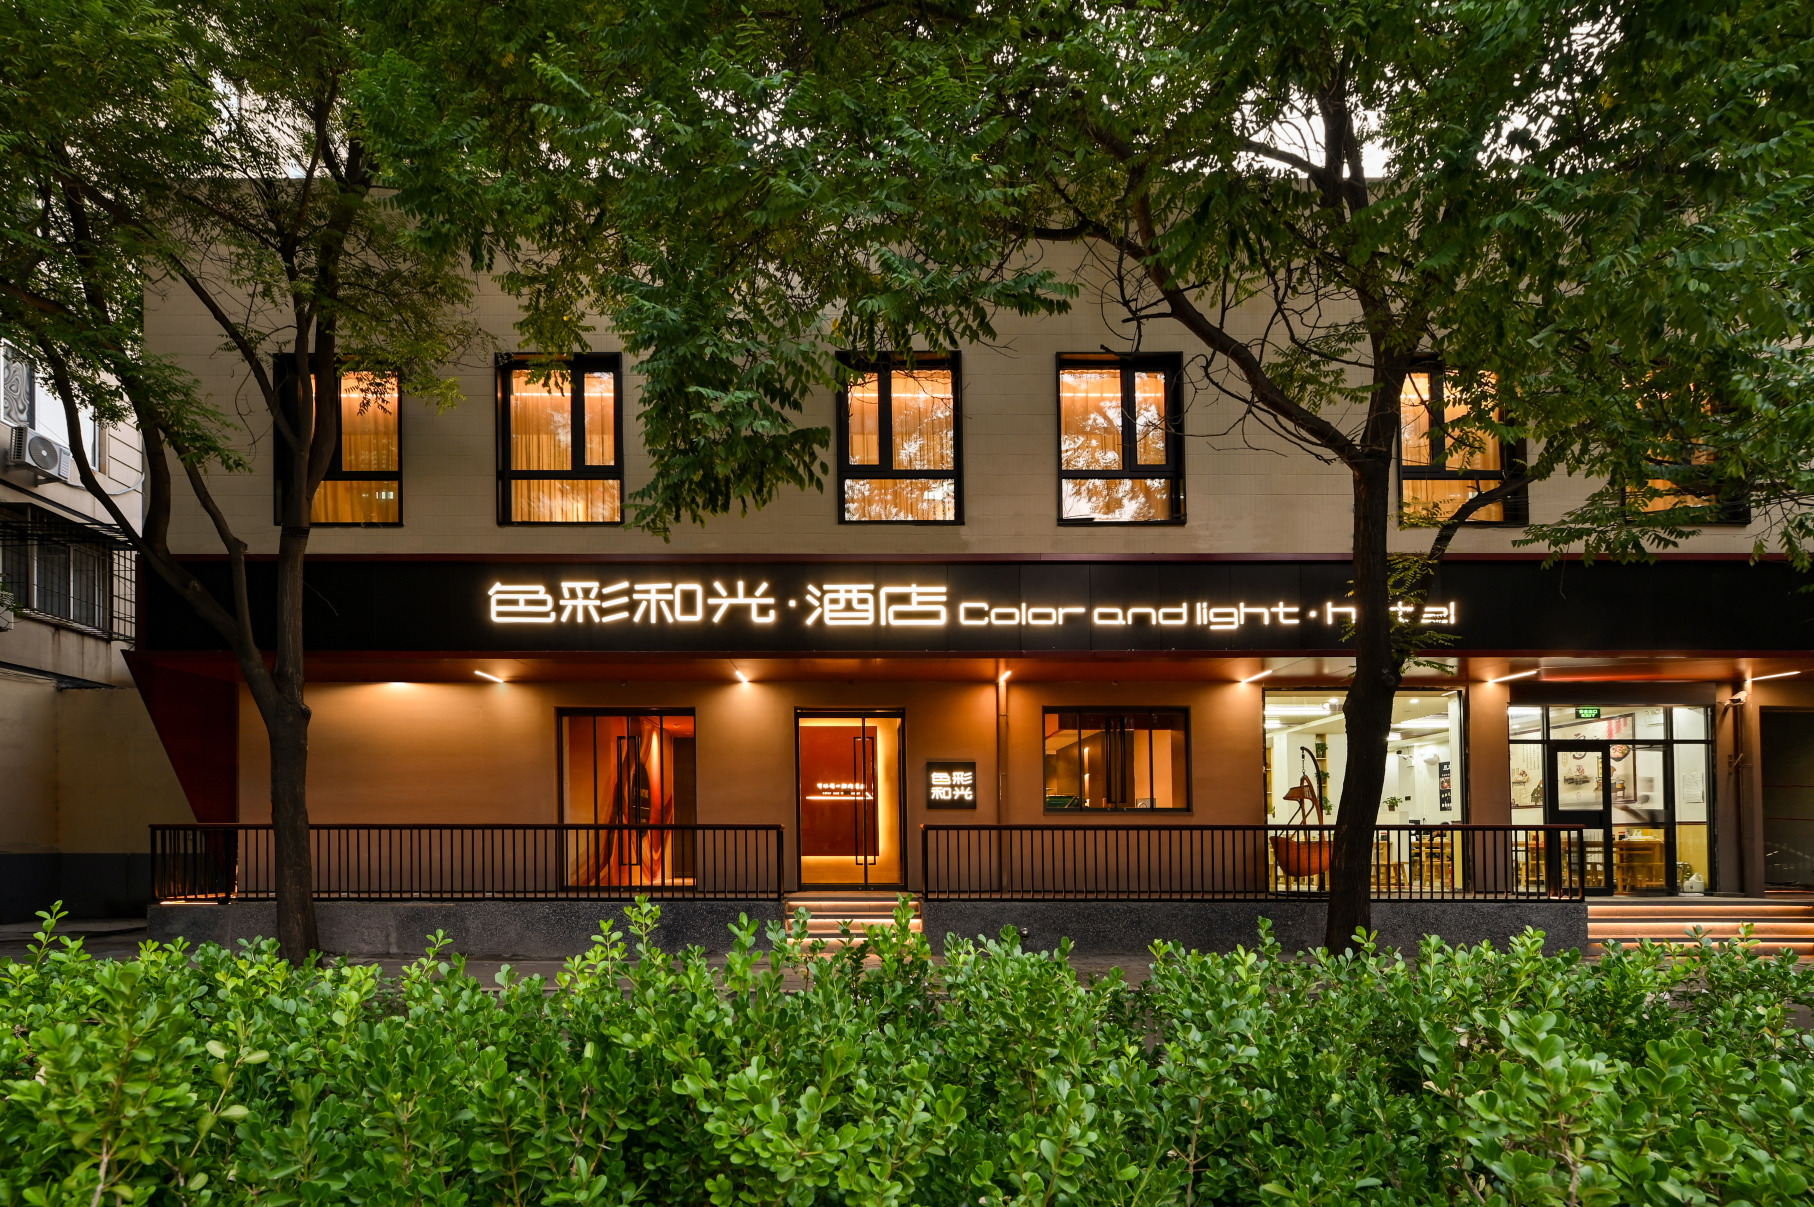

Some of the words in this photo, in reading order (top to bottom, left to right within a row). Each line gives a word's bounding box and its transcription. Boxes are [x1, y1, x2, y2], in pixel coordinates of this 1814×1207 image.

[958, 601, 1086, 626] Color
[1092, 602, 1188, 626] and
[1325, 601, 1456, 625] htel
[931, 771, 973, 785] 色彩
[931, 786, 973, 800] 和光
